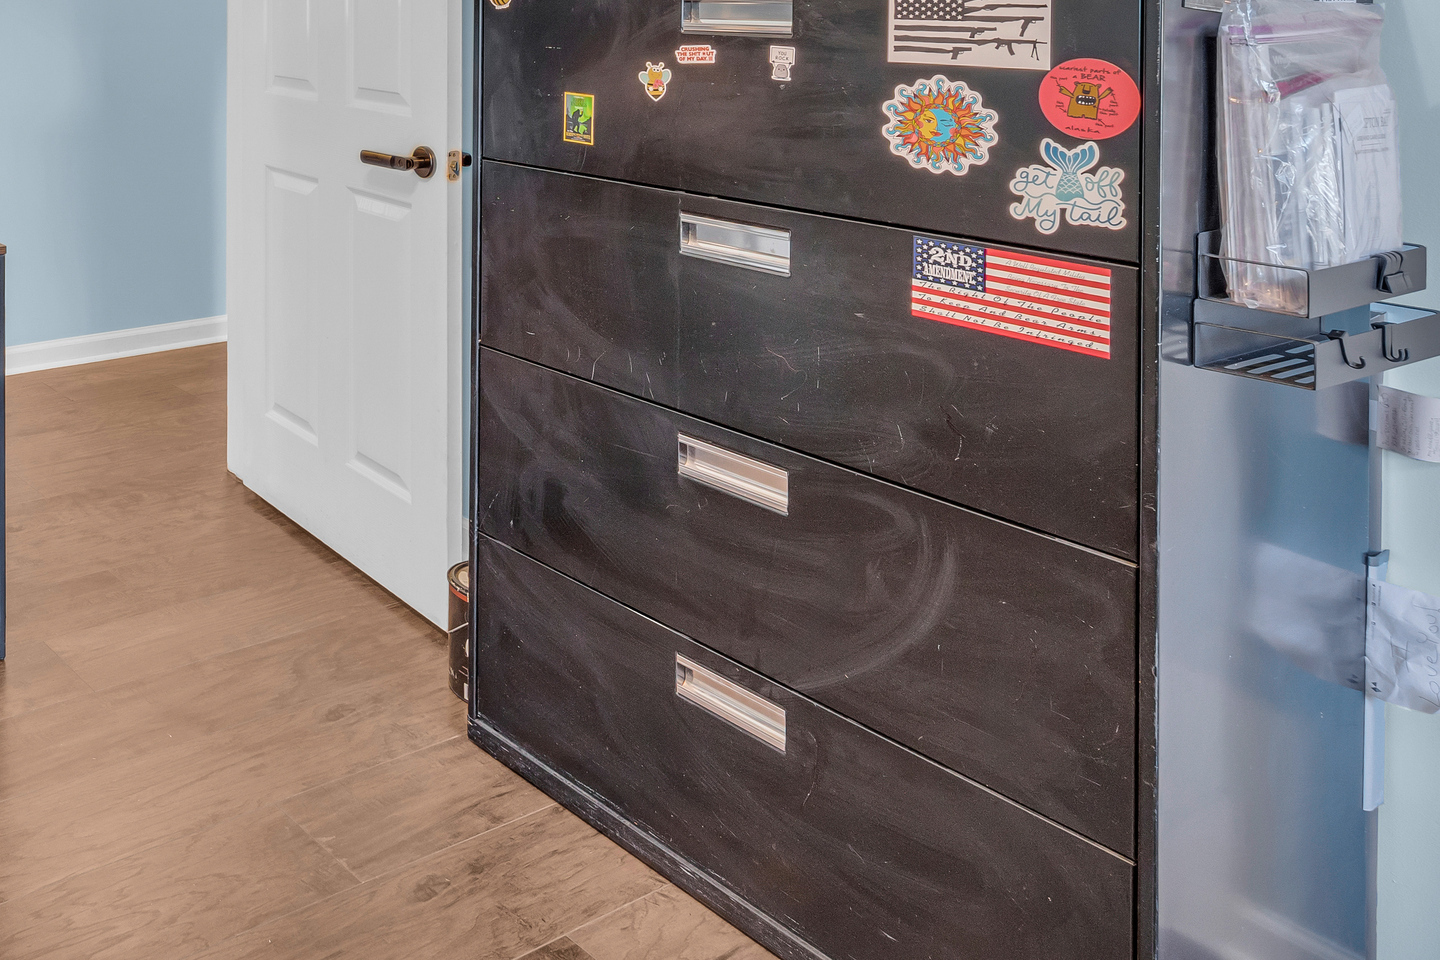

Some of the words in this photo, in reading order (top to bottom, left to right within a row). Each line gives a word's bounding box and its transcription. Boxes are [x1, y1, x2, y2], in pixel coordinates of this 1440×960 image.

[1080, 73, 1106, 82] BEAR
[1065, 125, 1101, 134] alaska
[1013, 167, 1057, 192] get
[1084, 169, 1121, 199] off
[1013, 197, 1057, 231] My
[1055, 200, 1123, 227] tail
[929, 246, 973, 268] 2ND
[923, 263, 976, 285] AMENDMENT
[918, 293, 932, 301] To
[939, 298, 970, 310] Keep
[978, 306, 1007, 316] And
[1014, 313, 1047, 325] Bear
[1056, 322, 1102, 338] Arms,
[919, 281, 942, 290] The
[948, 287, 987, 299] Right
[993, 295, 1009, 306] Of
[1017, 300, 1043, 311] The
[1050, 307, 1102, 323] People
[919, 306, 956, 318] Shall
[962, 315, 986, 325] Not
[993, 321, 1009, 330] Be
[1018, 326, 1099, 350] Infringed.
[1418, 647, 1440, 708] Love
